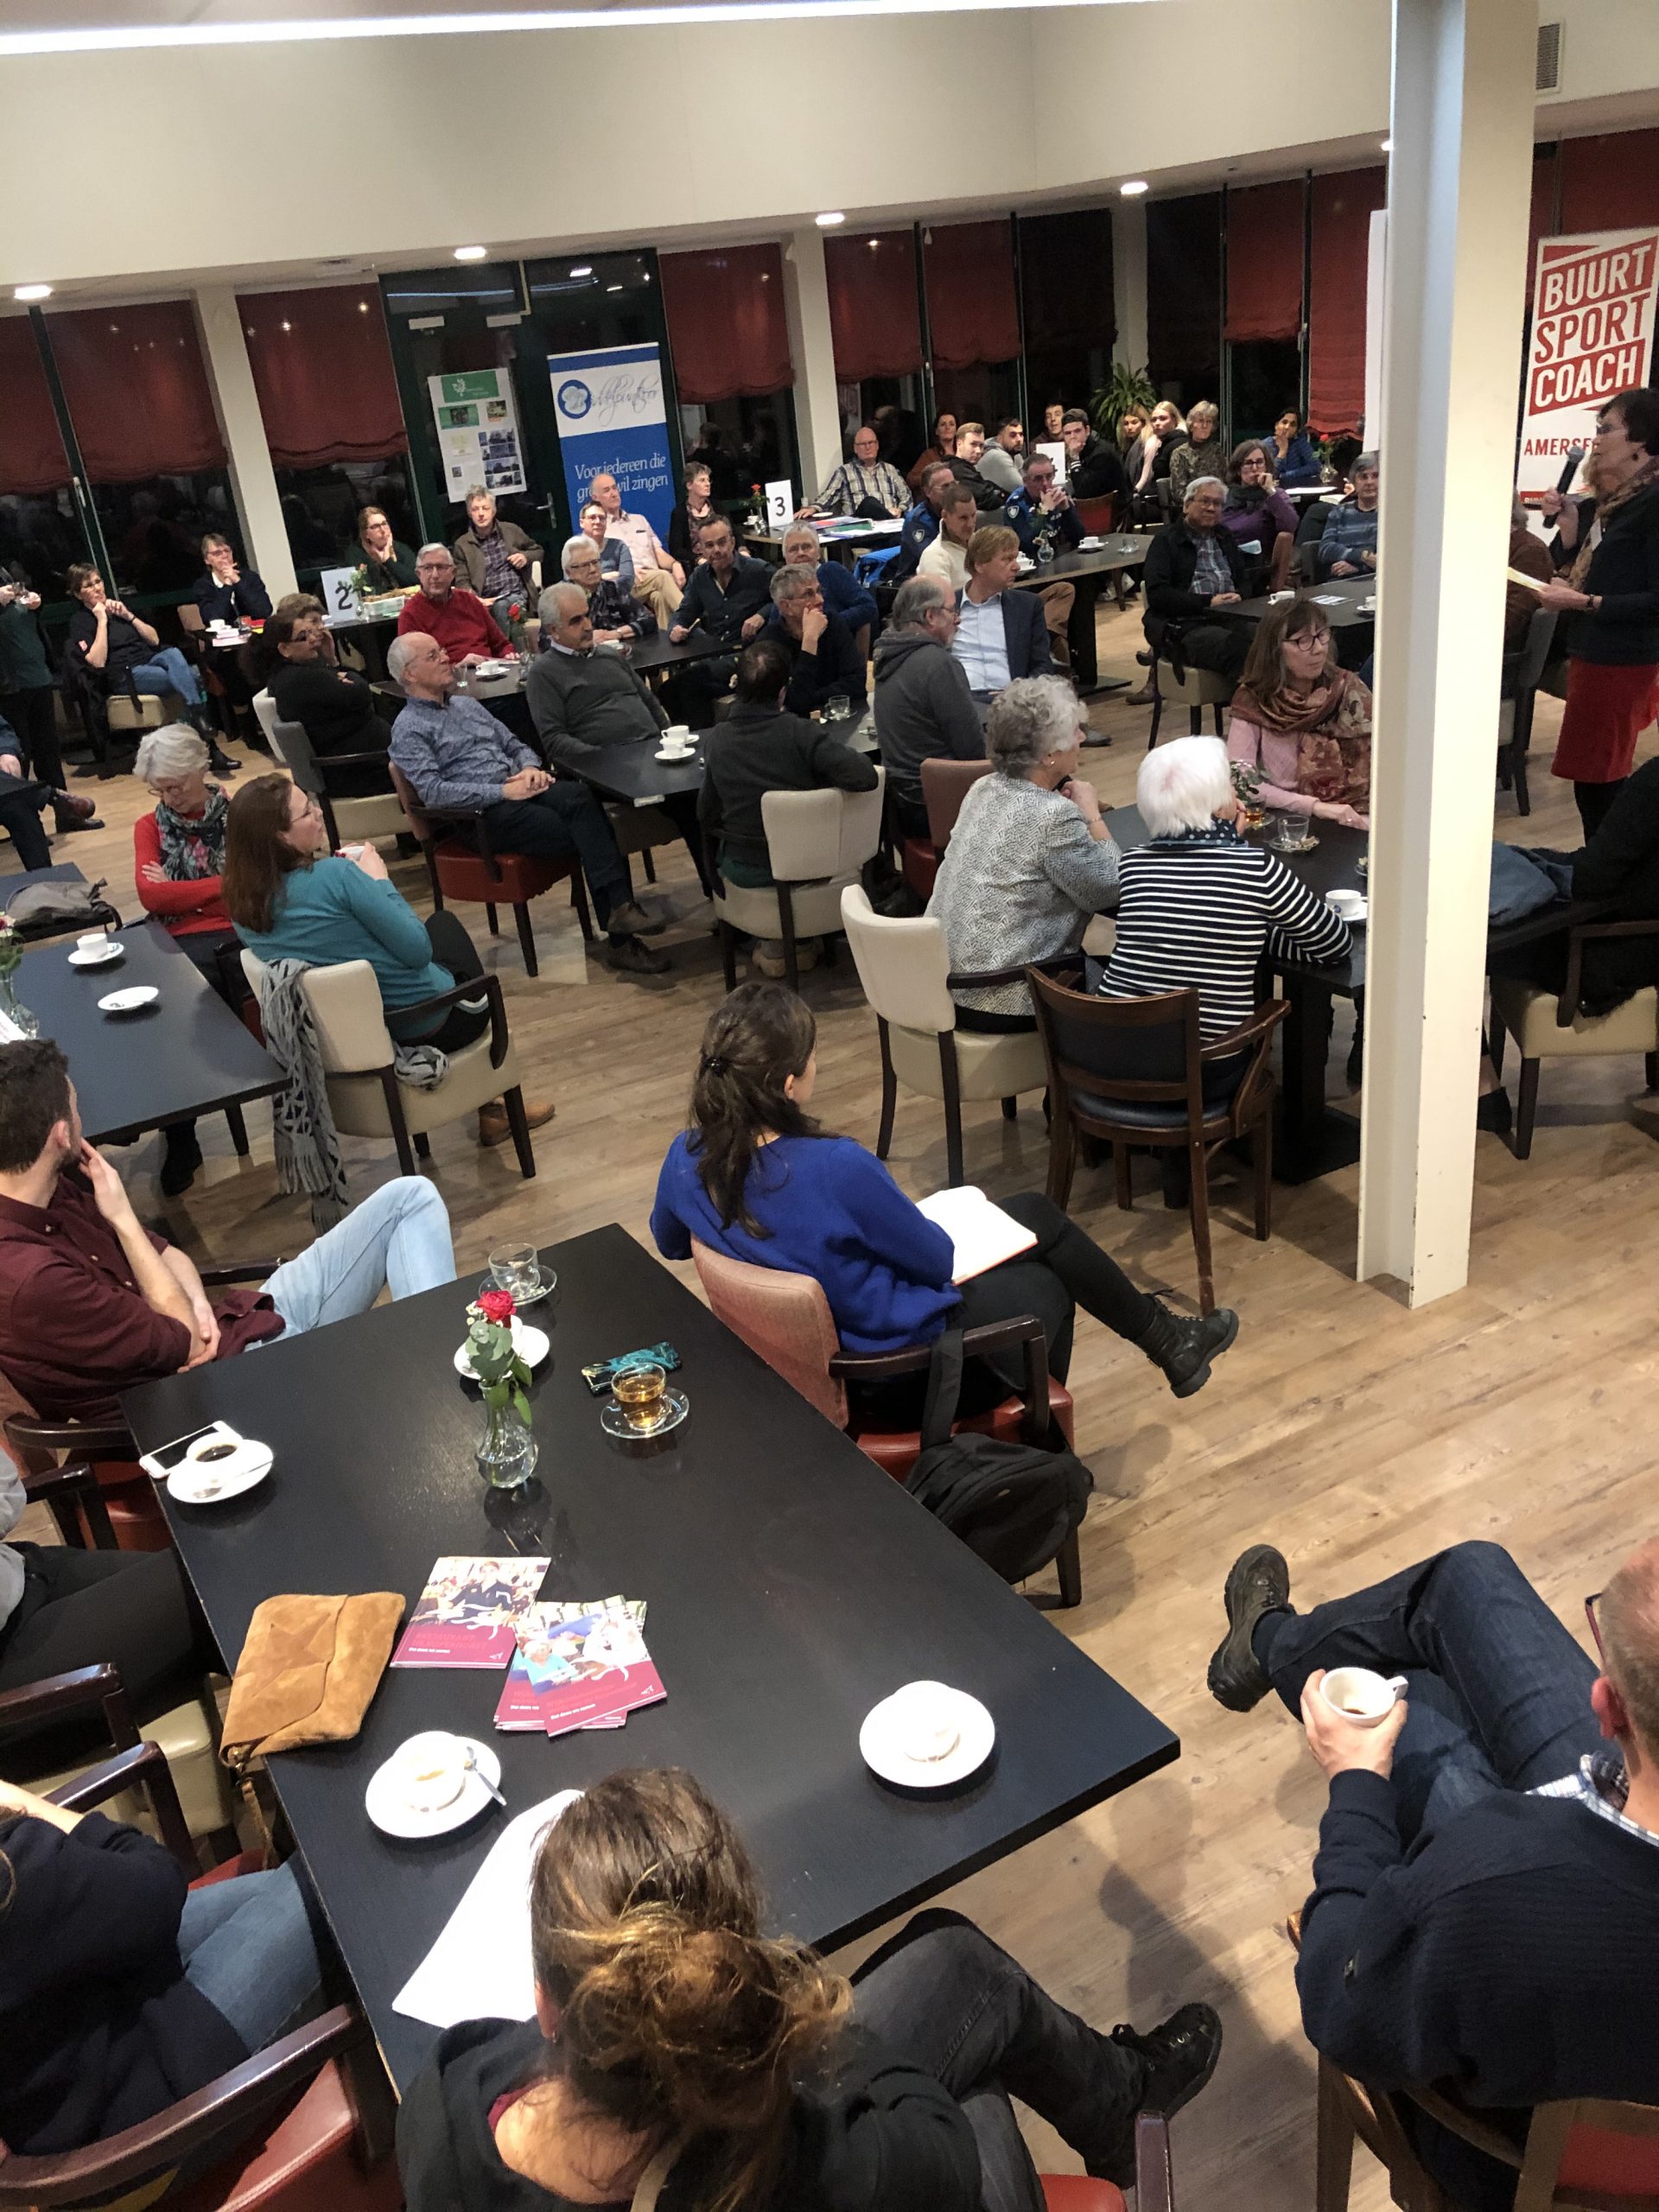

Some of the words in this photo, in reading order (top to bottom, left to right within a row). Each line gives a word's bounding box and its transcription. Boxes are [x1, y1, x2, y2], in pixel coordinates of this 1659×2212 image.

[1544, 245, 1652, 313] BUURT
[1535, 291, 1650, 364] SPORT
[1535, 346, 1636, 408] COACH
[1523, 438, 1595, 456] AMERSF
[575, 465, 601, 480] Voor
[603, 458, 647, 474] iedereen
[650, 452, 666, 468] die
[632, 474, 668, 492] zingen
[774, 497, 785, 517] 3
[335, 586, 353, 610] 2
